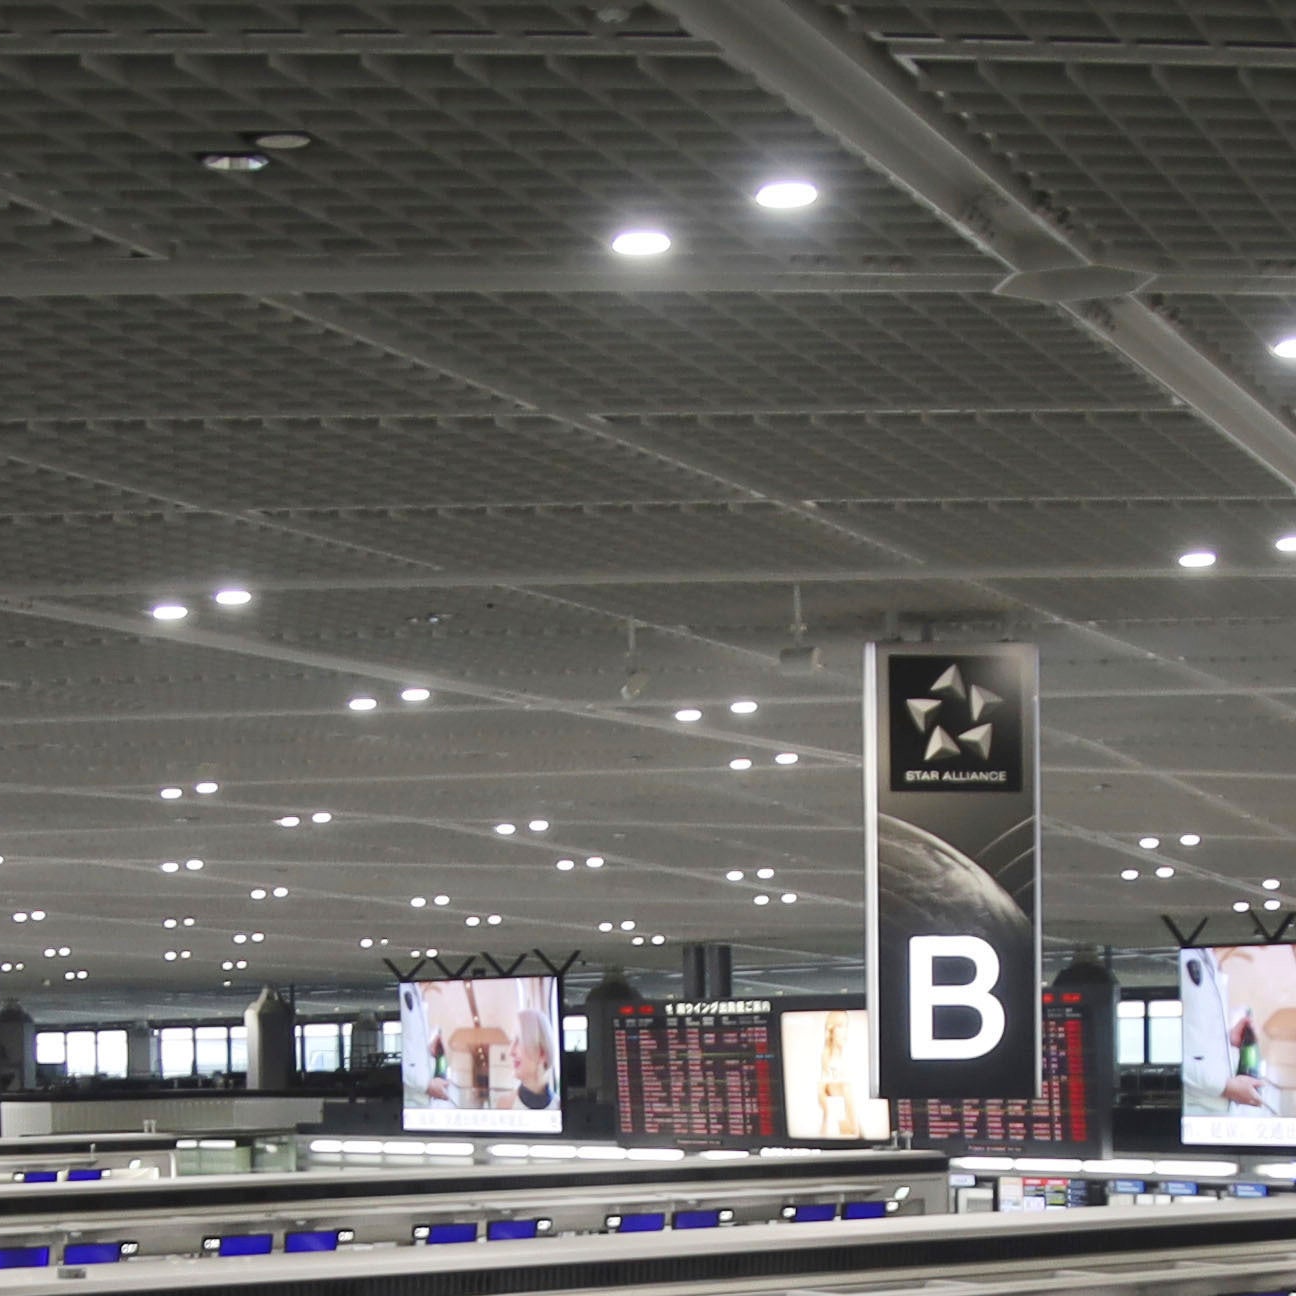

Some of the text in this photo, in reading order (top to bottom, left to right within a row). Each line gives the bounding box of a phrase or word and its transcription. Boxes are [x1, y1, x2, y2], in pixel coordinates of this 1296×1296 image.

[905, 769, 1007, 781] STAR ALLIANCE
[909, 935, 1006, 1061] B
